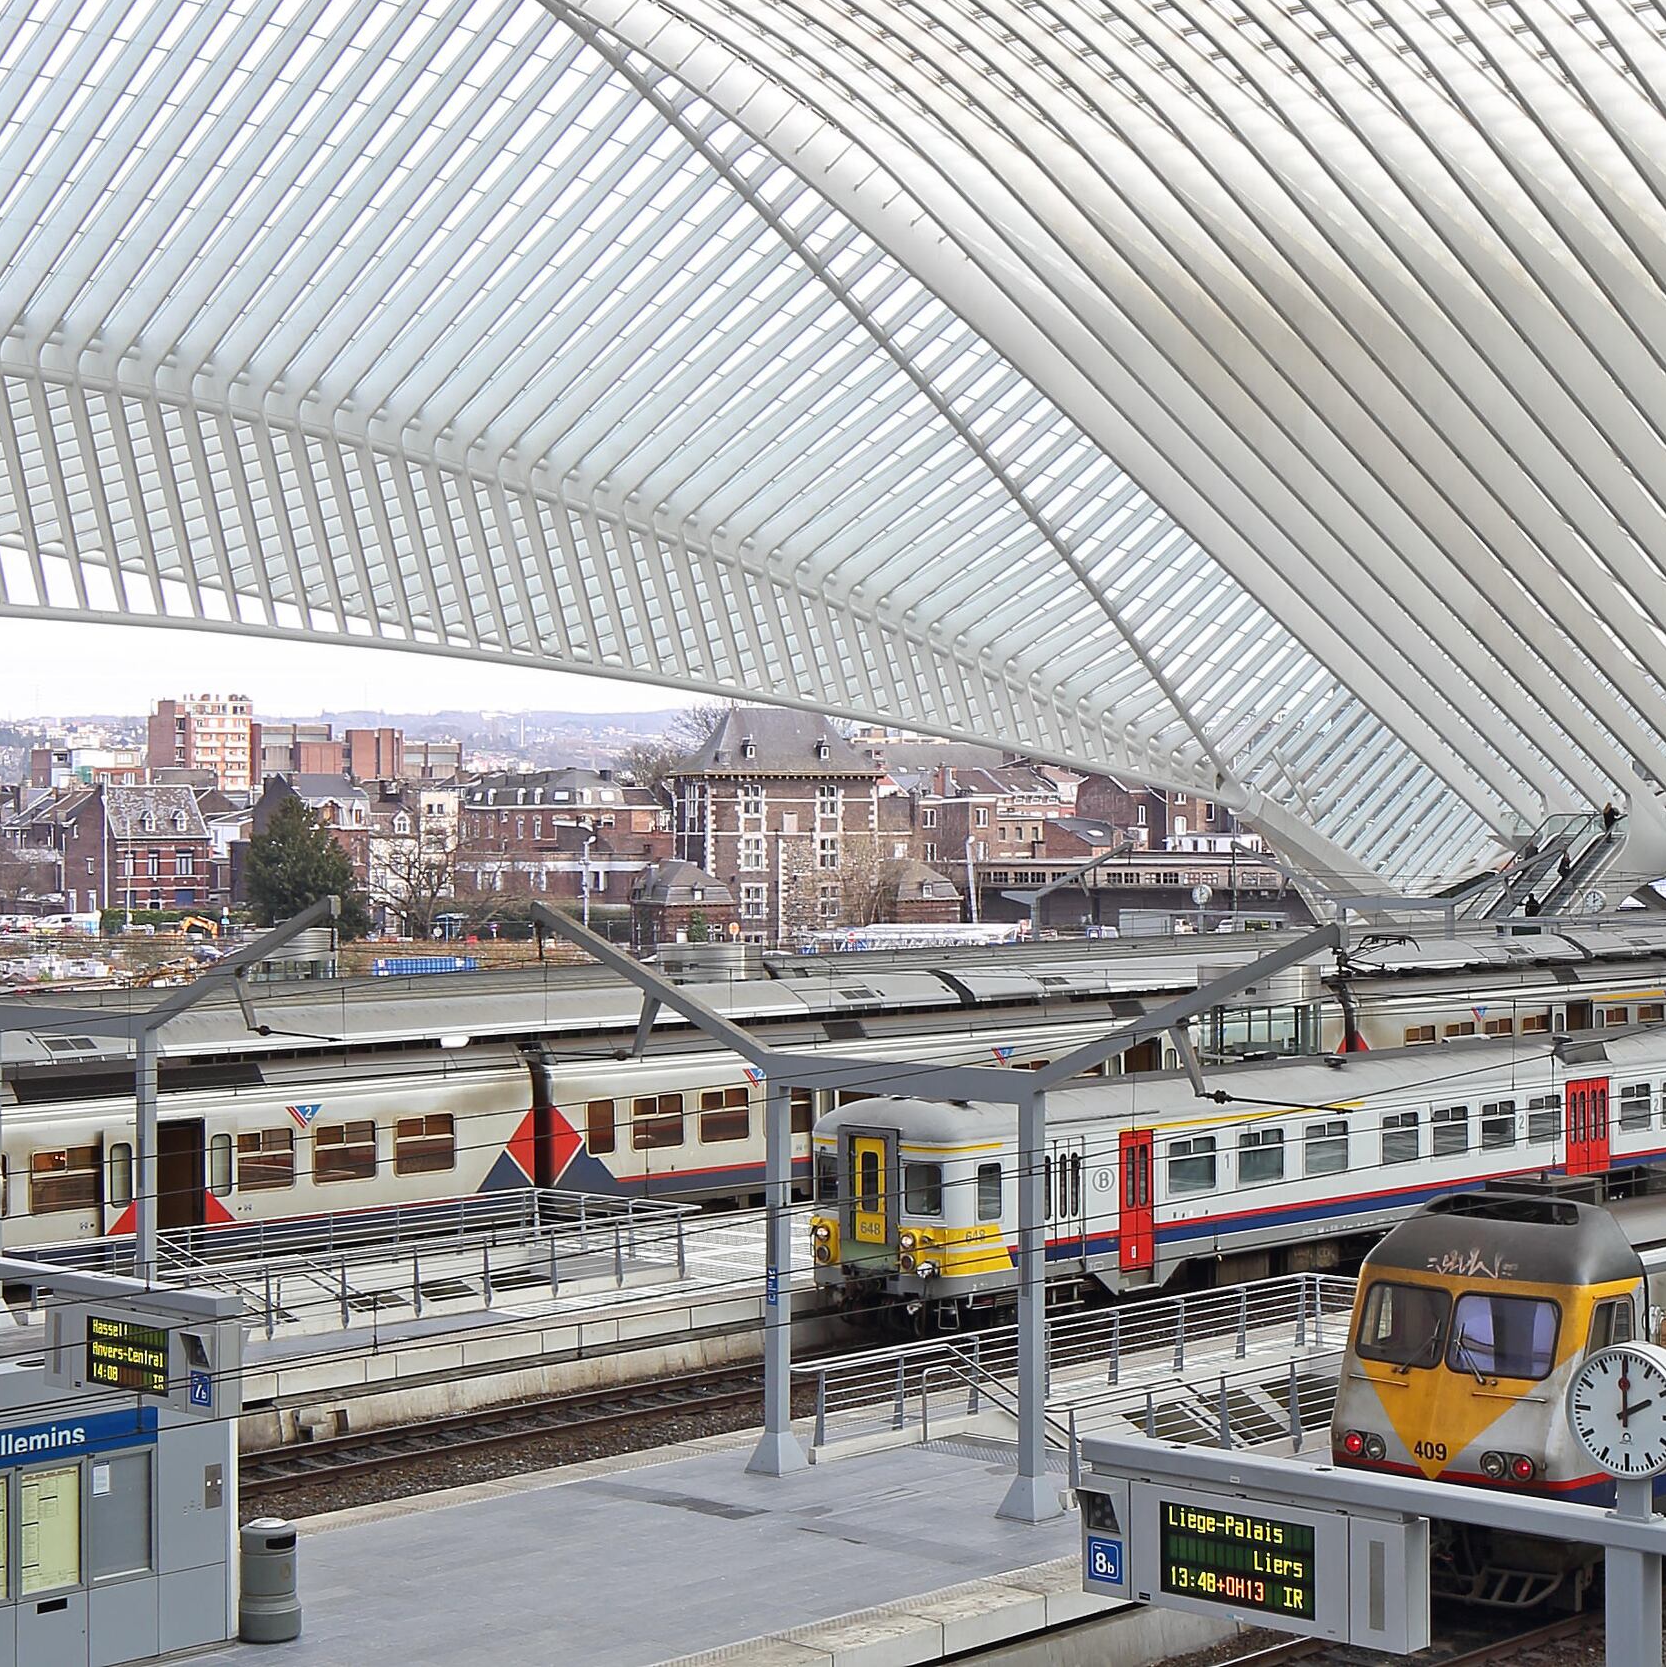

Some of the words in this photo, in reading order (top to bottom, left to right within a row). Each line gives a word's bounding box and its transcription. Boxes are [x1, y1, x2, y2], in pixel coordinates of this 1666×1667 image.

[757, 1069, 764, 1080] 2
[304, 1106, 313, 1119] 2
[1653, 1098, 1660, 1112] 2
[1518, 1115, 1525, 1130] 2
[1225, 1153, 1230, 1169] 1
[860, 1221, 881, 1236] 648
[965, 1229, 986, 1245] 648
[92, 1318, 128, 1337] Hasselt
[92, 1341, 164, 1368] Anvers-Central
[93, 1362, 118, 1381] 14:08
[1413, 1440, 1447, 1461] 409
[1168, 1505, 1284, 1545] Liège-Palais
[1094, 1552, 1115, 1575] 8b
[1253, 1550, 1303, 1579] Liers
[1170, 1565, 1265, 1602] 13:48+0H13
[1282, 1586, 1303, 1610] IR
